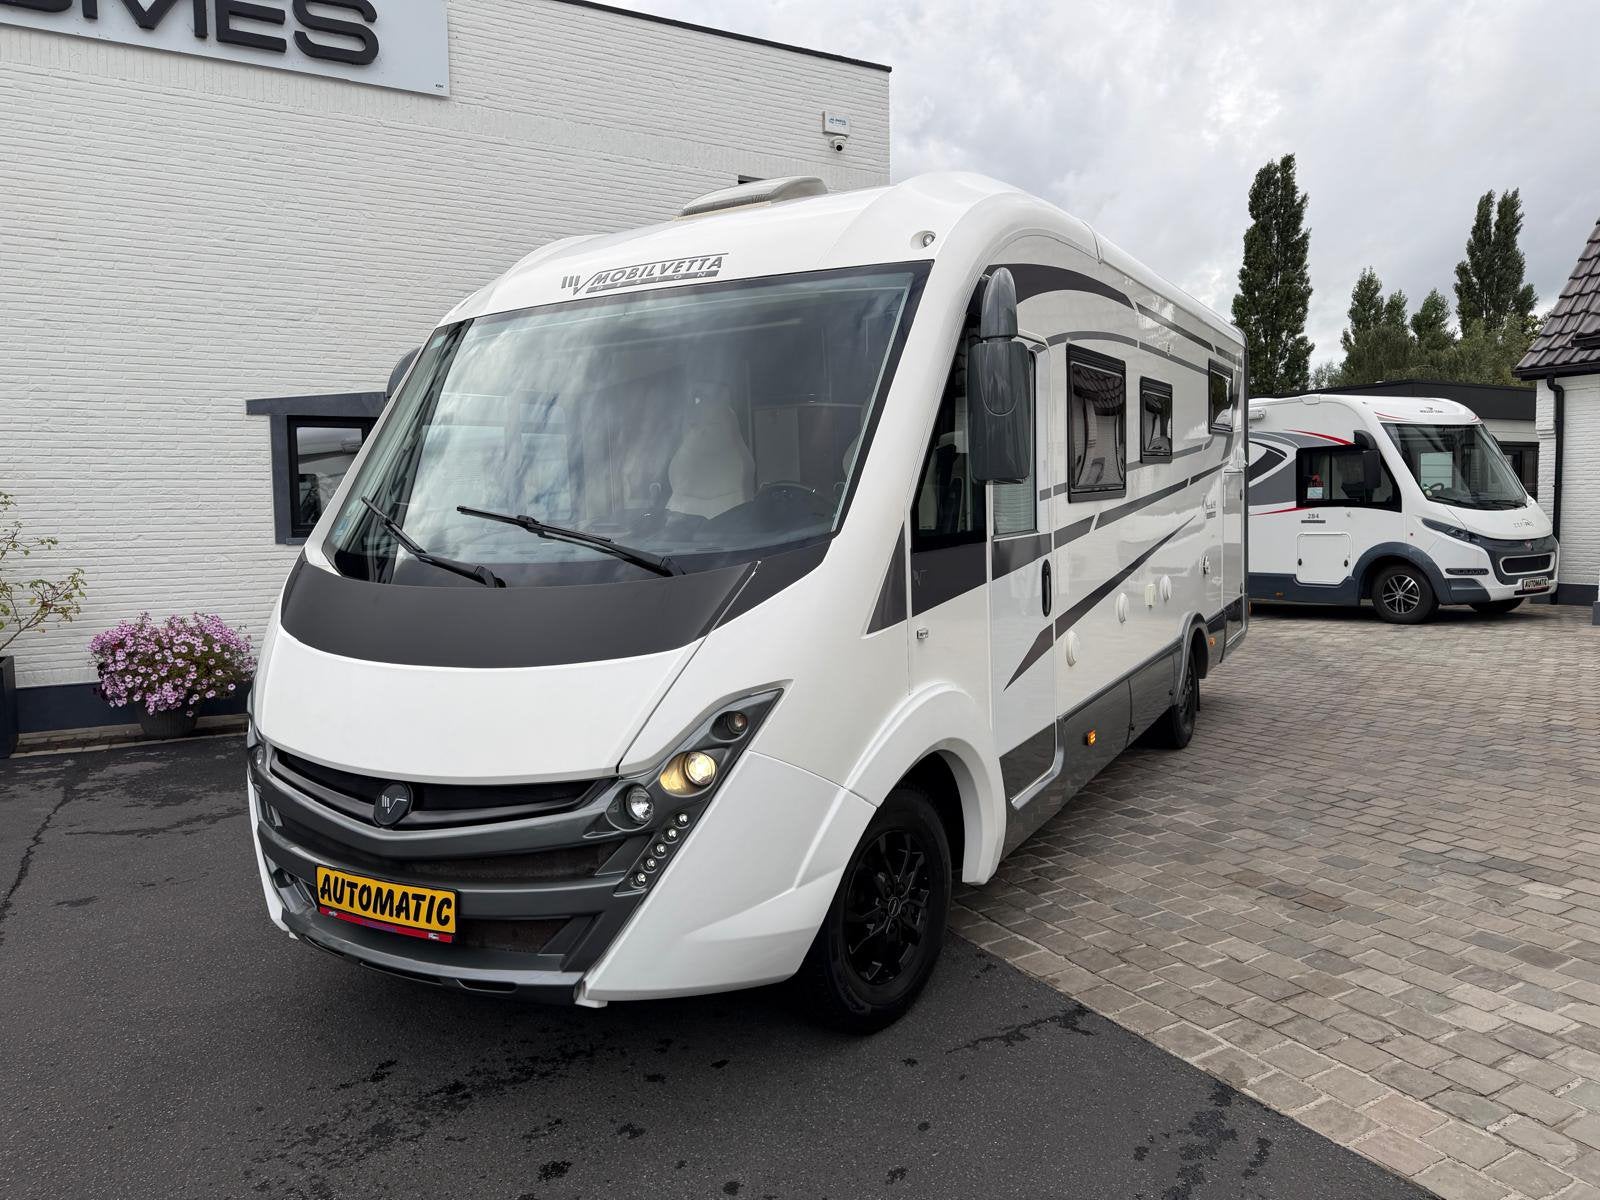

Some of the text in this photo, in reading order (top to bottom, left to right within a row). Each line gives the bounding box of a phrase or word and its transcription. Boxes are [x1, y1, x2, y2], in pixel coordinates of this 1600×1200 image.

[591, 256, 723, 287] MOBILVETTA
[1524, 578, 1548, 588] AUTOMATIC
[320, 873, 452, 927] AUTOMATIC
